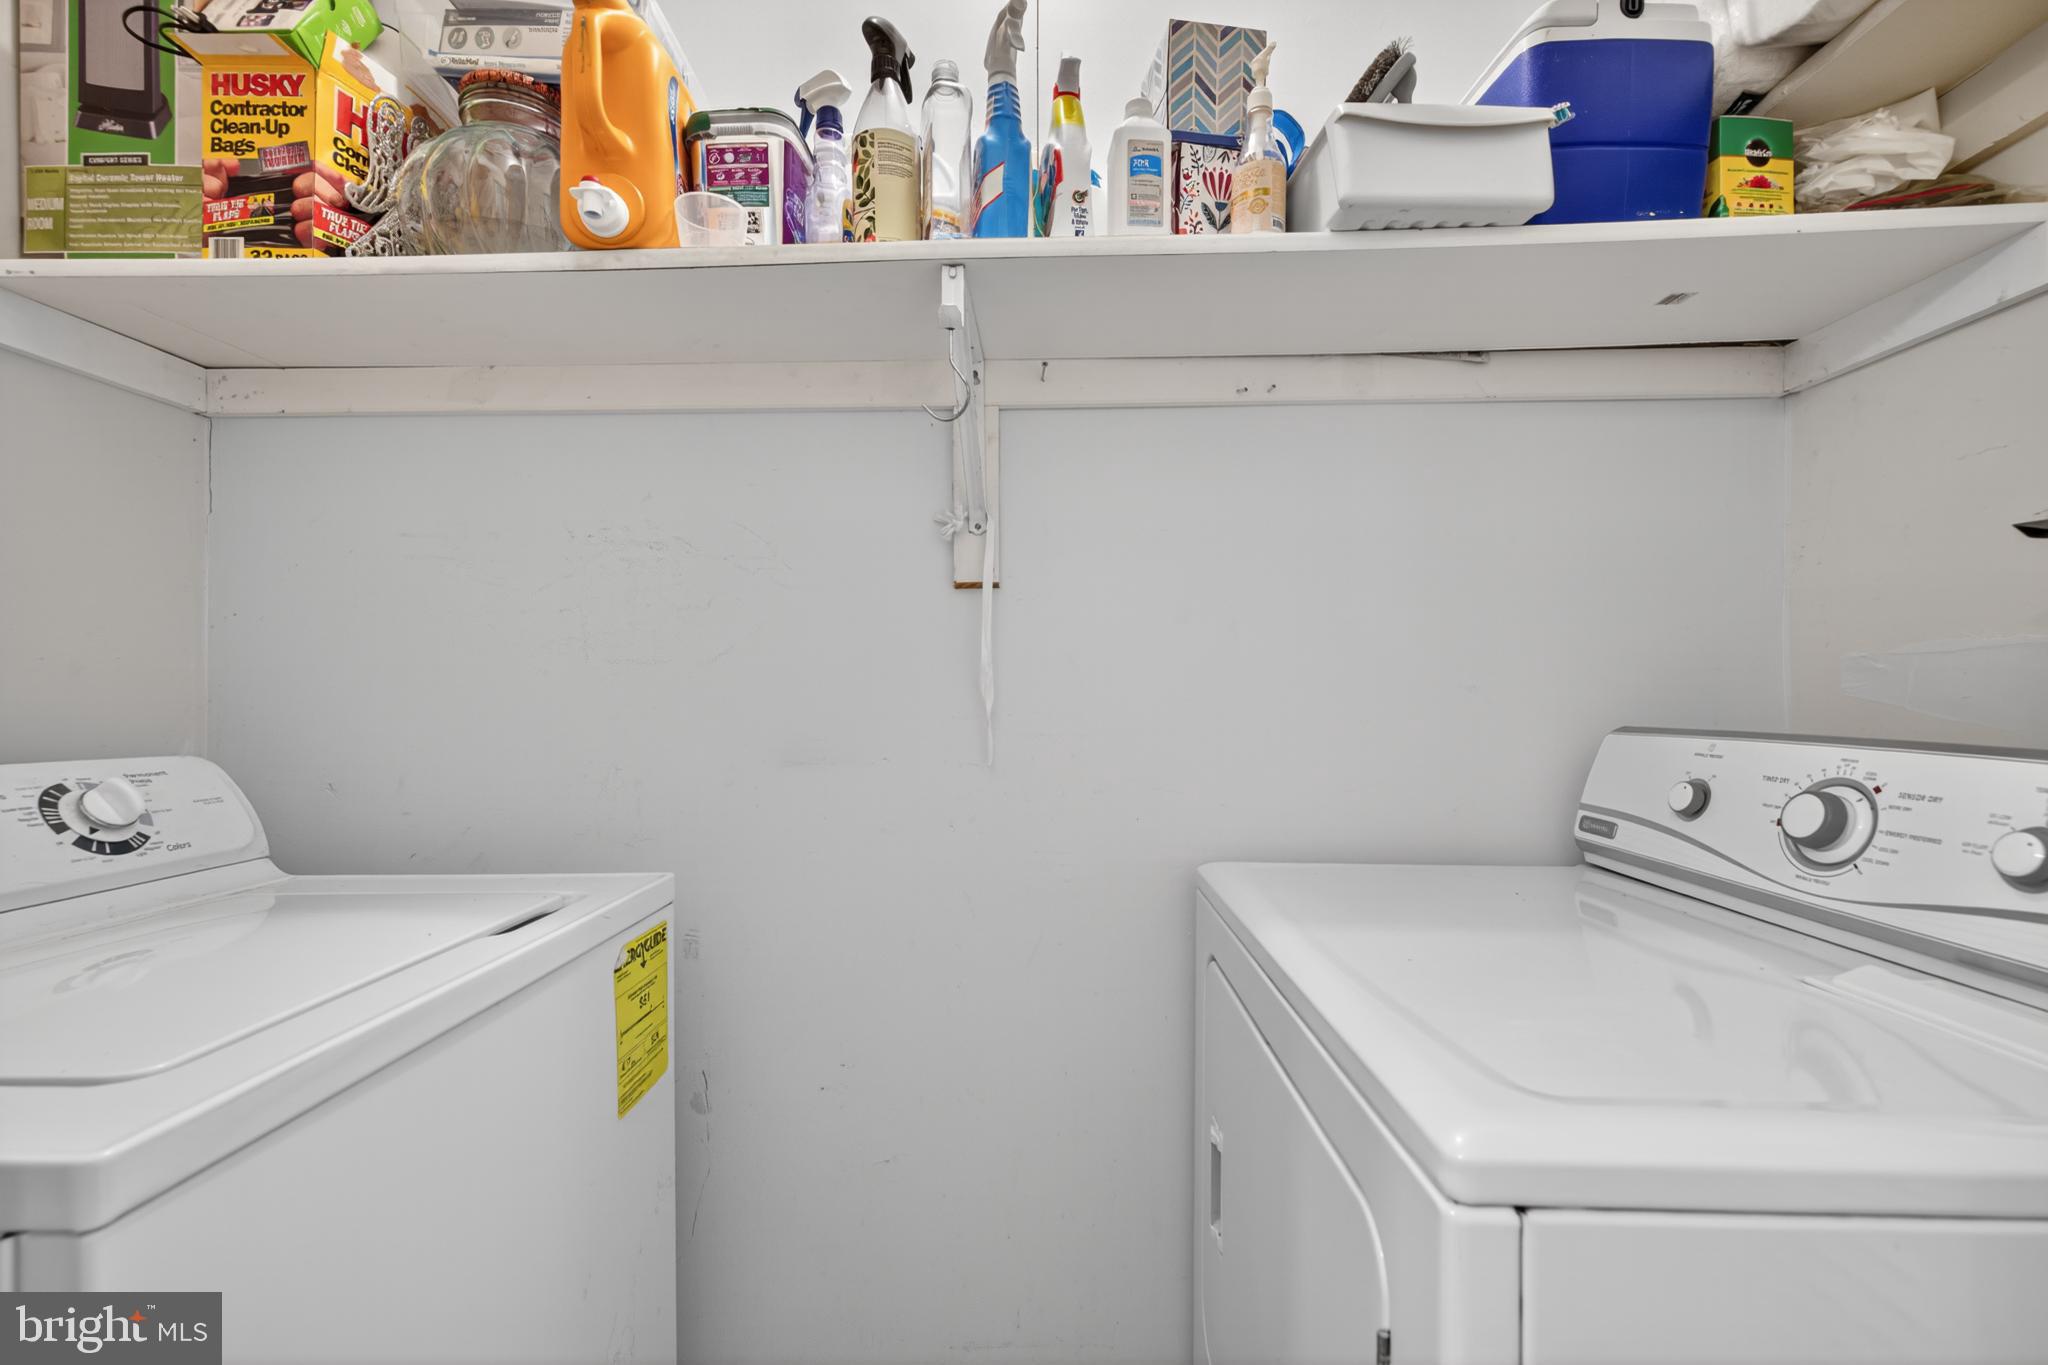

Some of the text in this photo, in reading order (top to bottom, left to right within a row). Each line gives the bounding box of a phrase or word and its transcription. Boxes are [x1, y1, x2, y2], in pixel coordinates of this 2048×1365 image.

[211, 73, 306, 96] HUSKY
[210, 100, 308, 117] Contractor
[210, 119, 290, 138] Clean-Up
[211, 137, 256, 156] Bags
[166, 842, 192, 852] Colors
